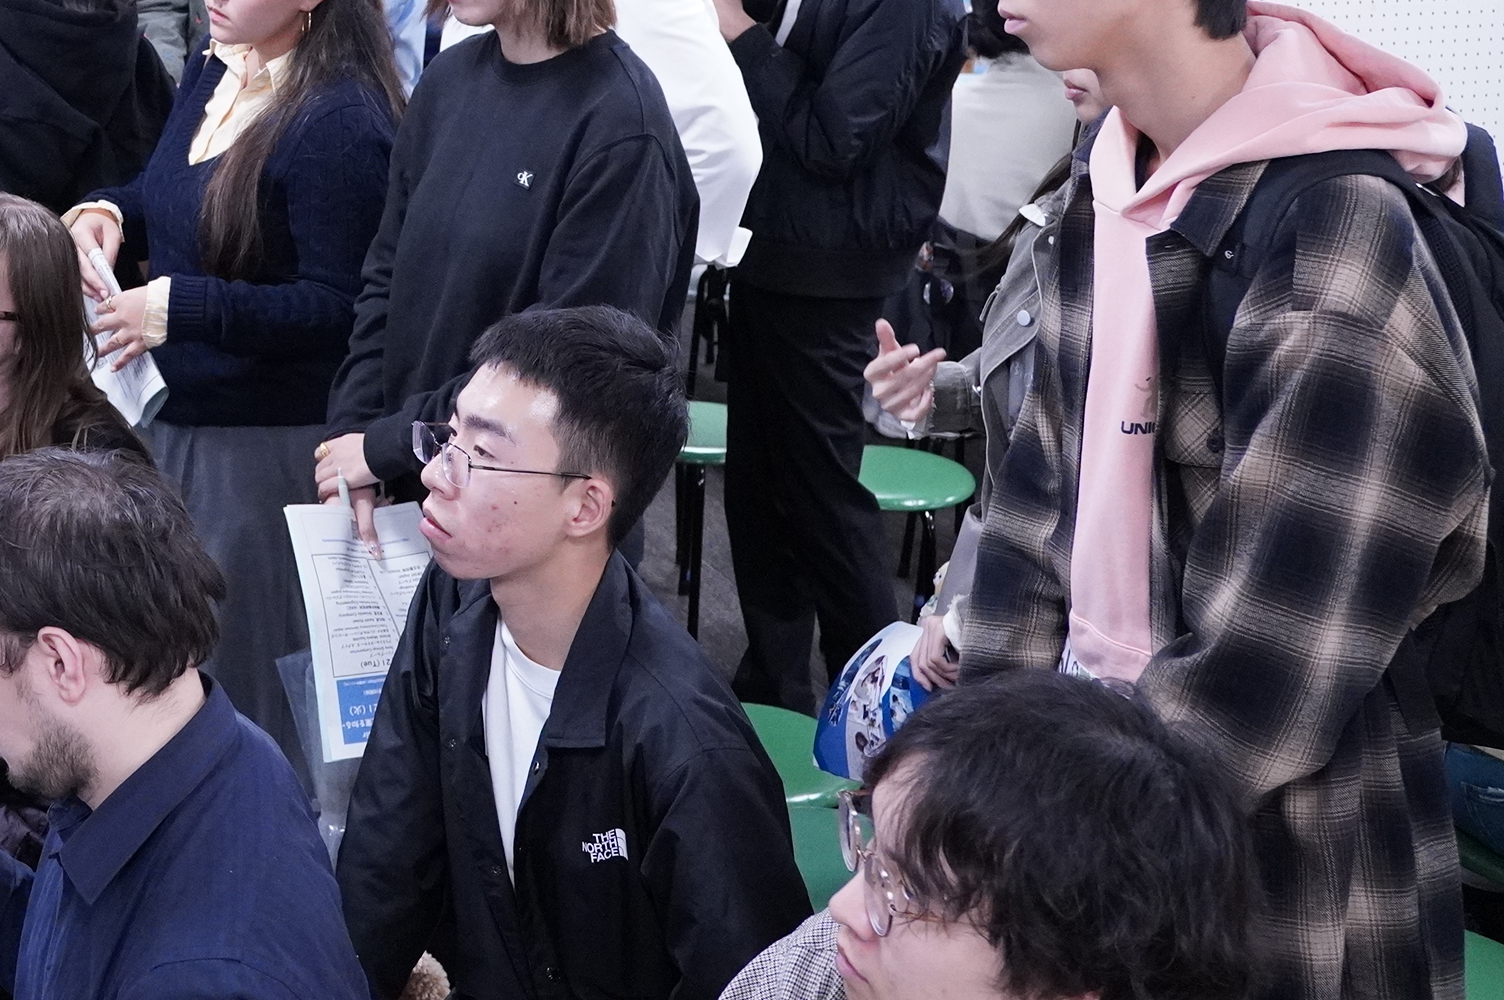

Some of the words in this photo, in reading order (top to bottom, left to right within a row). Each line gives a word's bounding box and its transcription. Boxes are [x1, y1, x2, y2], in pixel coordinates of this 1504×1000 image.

[592, 828, 616, 844] THE
[581, 837, 618, 853] NORTH
[590, 847, 619, 863] FACE
